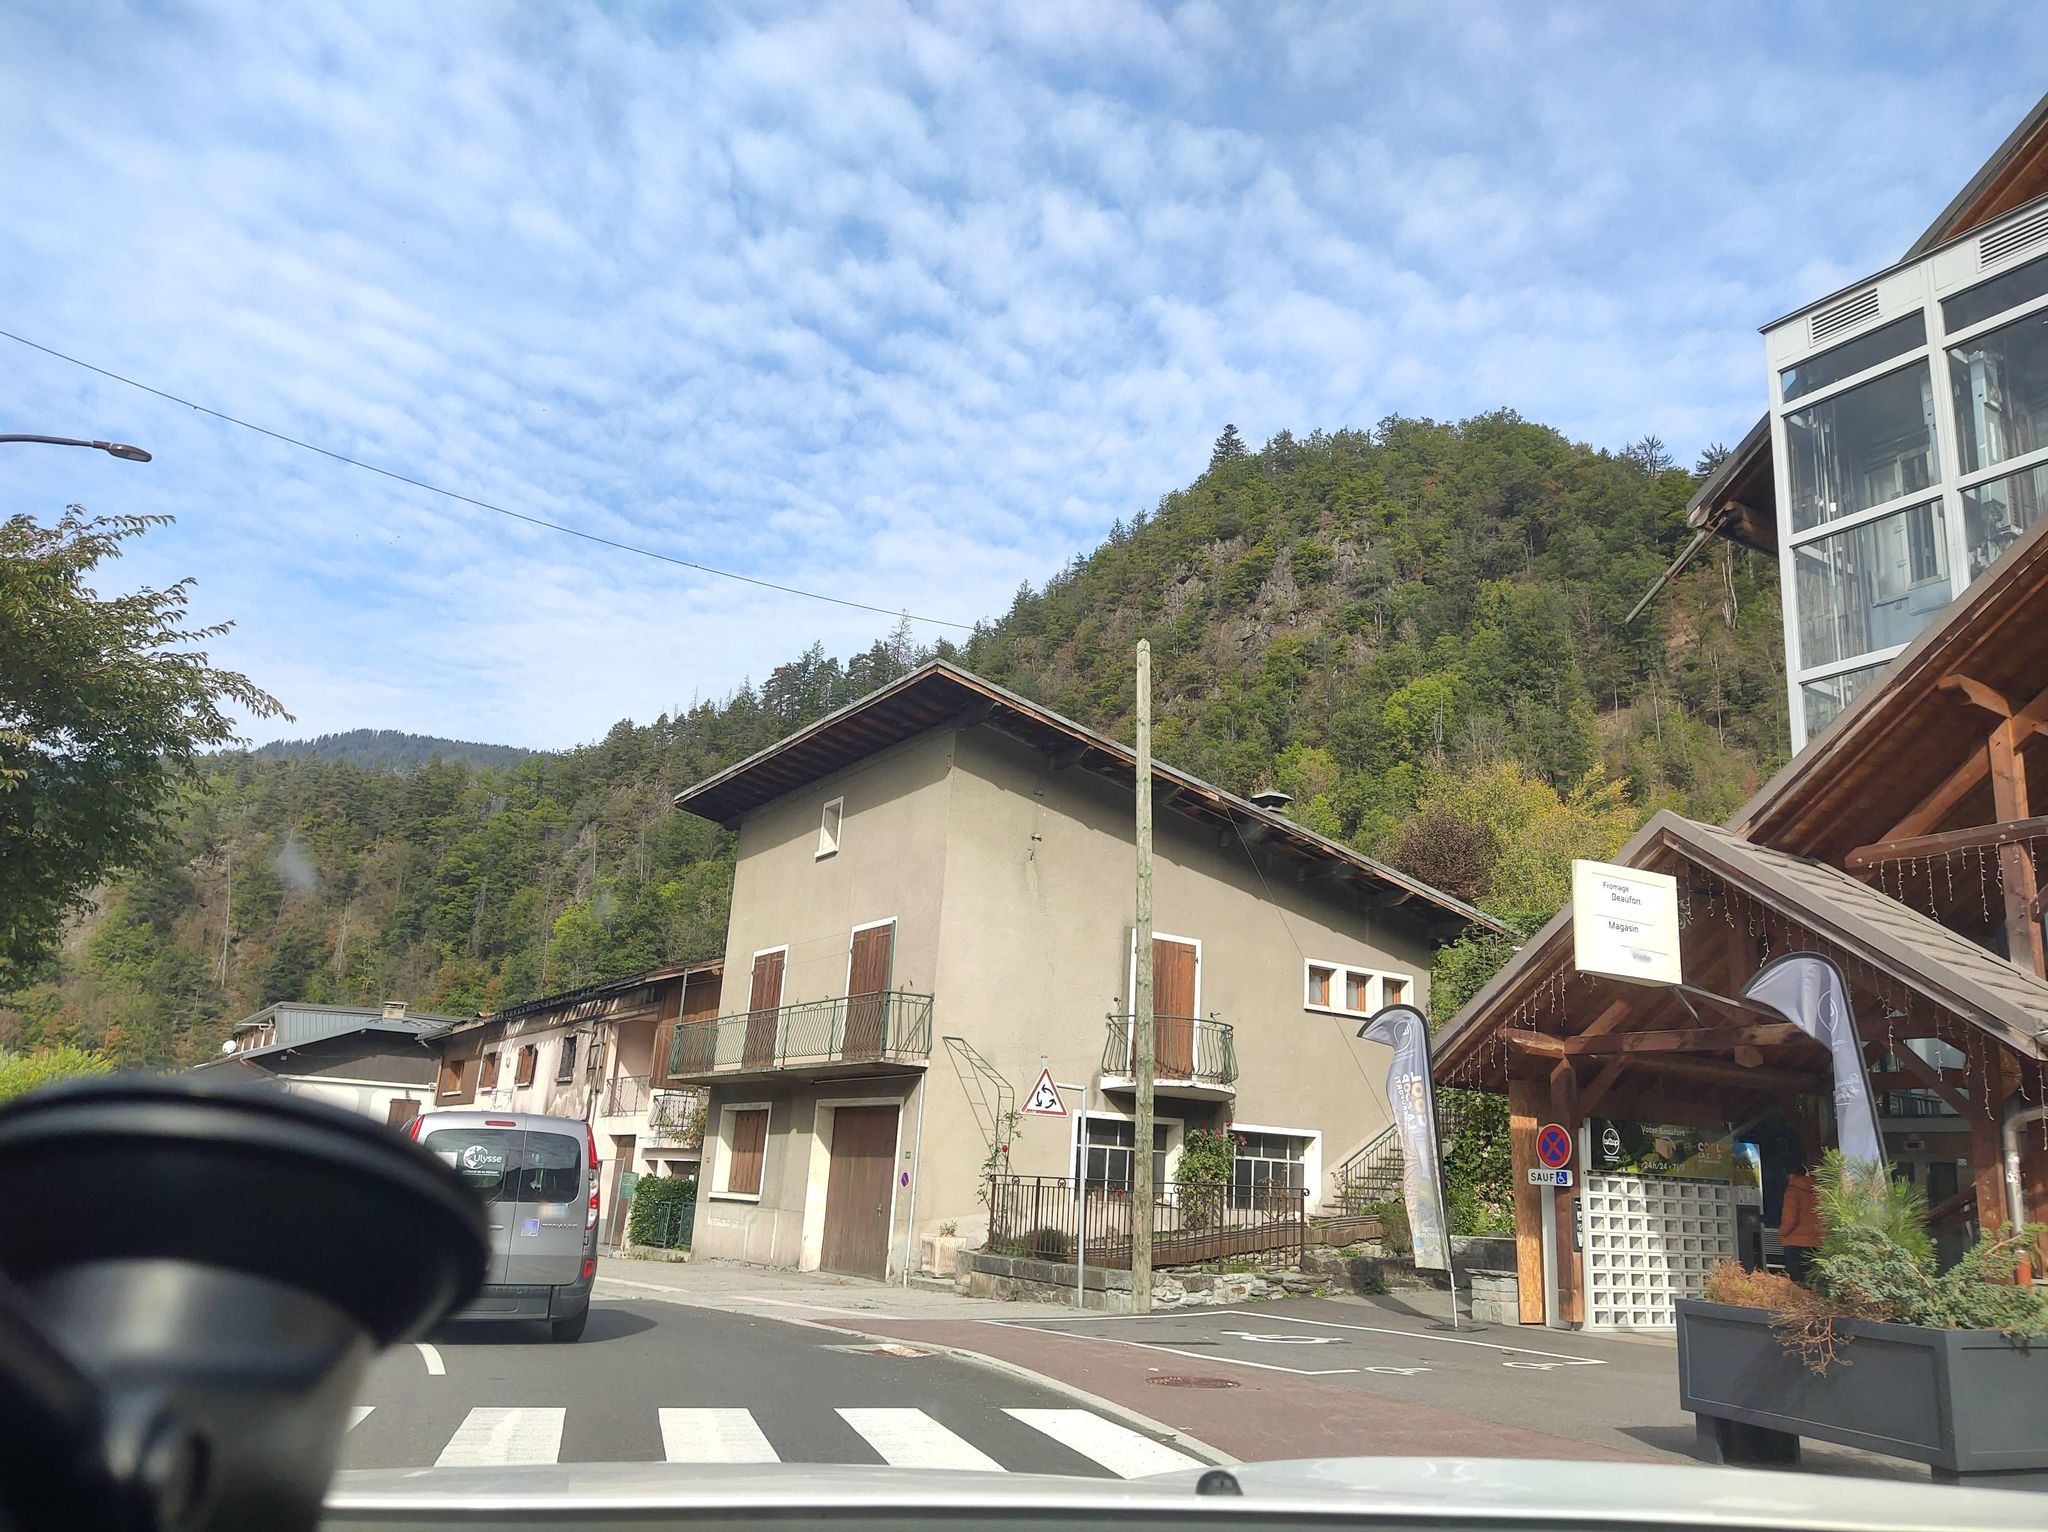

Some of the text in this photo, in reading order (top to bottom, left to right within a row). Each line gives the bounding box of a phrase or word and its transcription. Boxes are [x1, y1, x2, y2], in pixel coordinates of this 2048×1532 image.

[1602, 881, 1630, 893] Fromage
[1611, 893, 1642, 905] Beaufort
[1608, 921, 1639, 933] Magasin
[473, 1153, 502, 1164] Ulysse
[1530, 1172, 1555, 1182] SAUF
